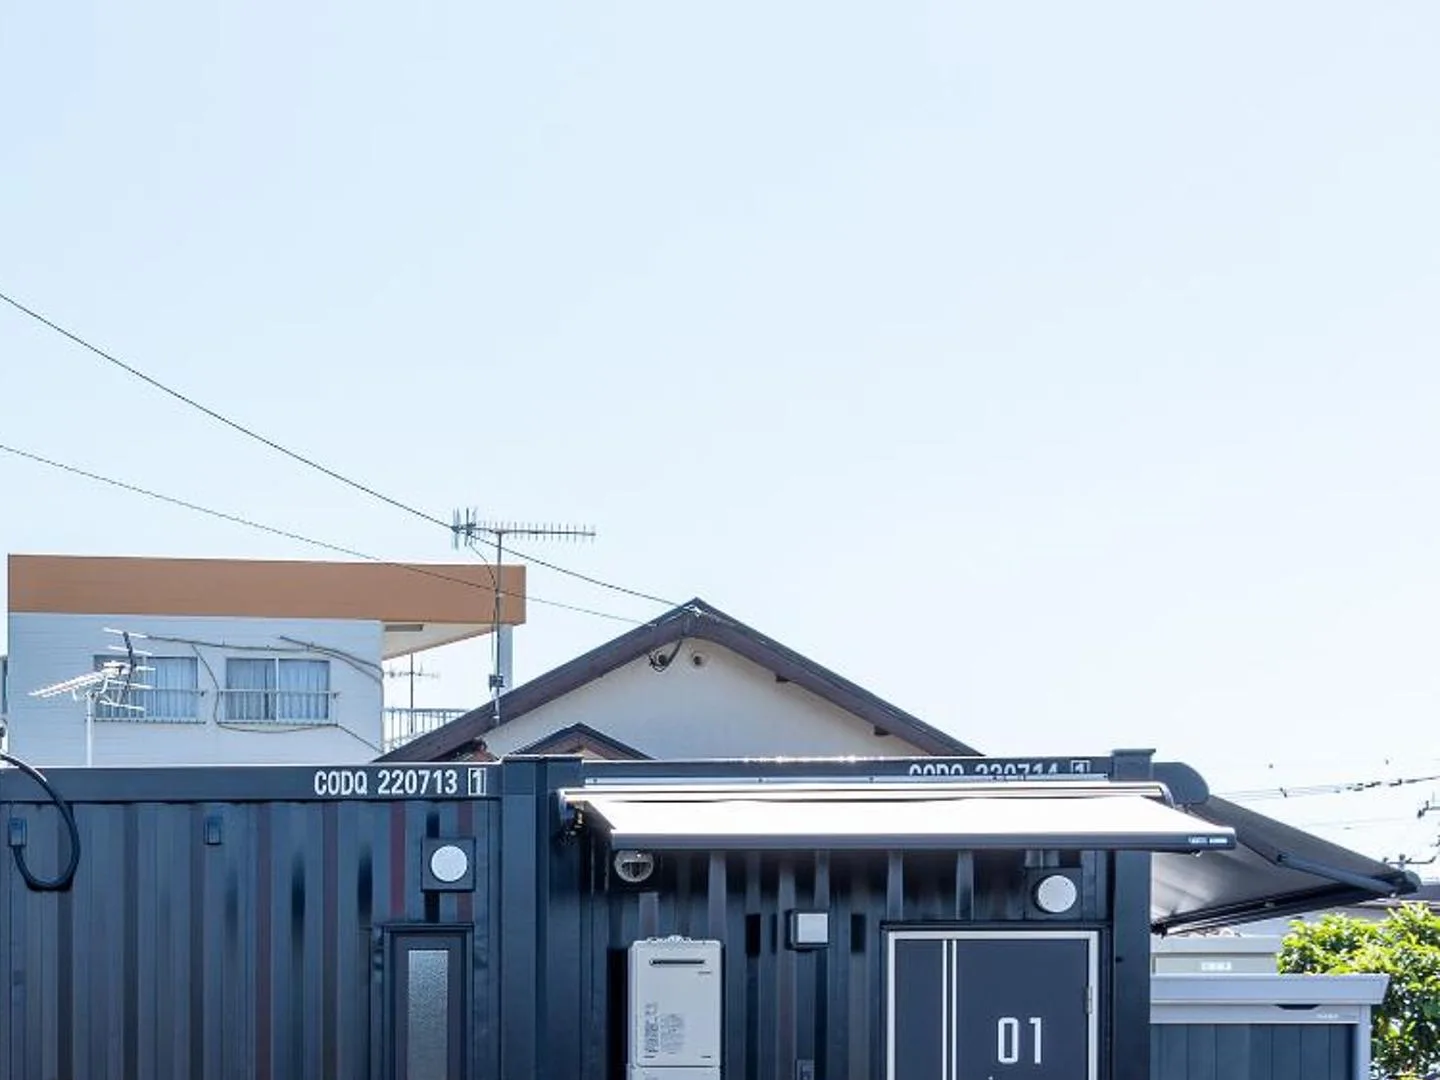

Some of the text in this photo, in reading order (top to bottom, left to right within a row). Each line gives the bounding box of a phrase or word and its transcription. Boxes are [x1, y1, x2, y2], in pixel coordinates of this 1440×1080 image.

[314, 769, 483, 795] CODQ 220713 1
[998, 1017, 1041, 1064] 01
